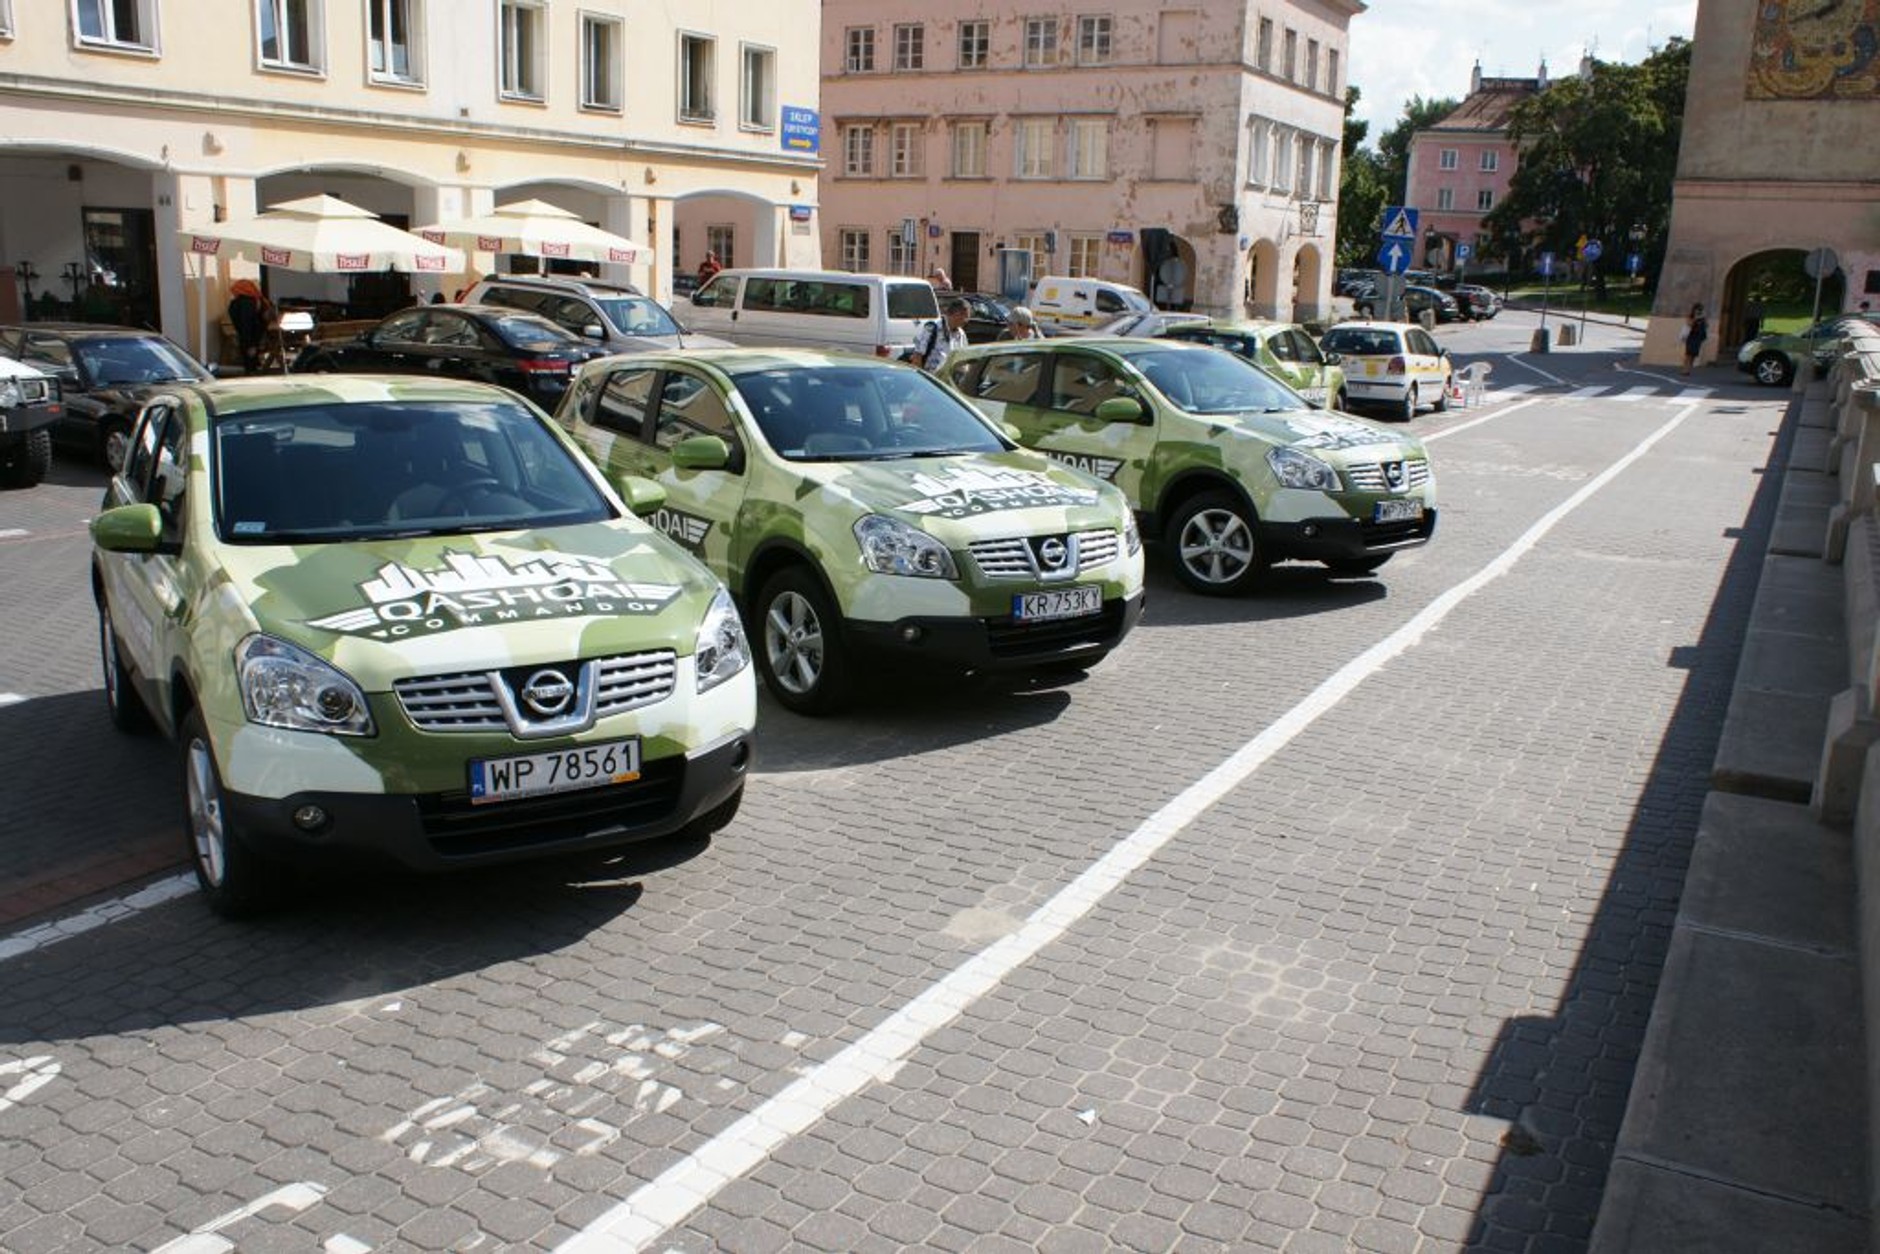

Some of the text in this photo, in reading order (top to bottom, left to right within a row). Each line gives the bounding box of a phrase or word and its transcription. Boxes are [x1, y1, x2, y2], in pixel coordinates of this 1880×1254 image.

[378, 582, 636, 621] QASHQAI
[390, 601, 644, 635] COMMANDO
[1024, 587, 1099, 616] KR 753KY
[491, 760, 534, 791] WP
[547, 744, 632, 784] 78561
